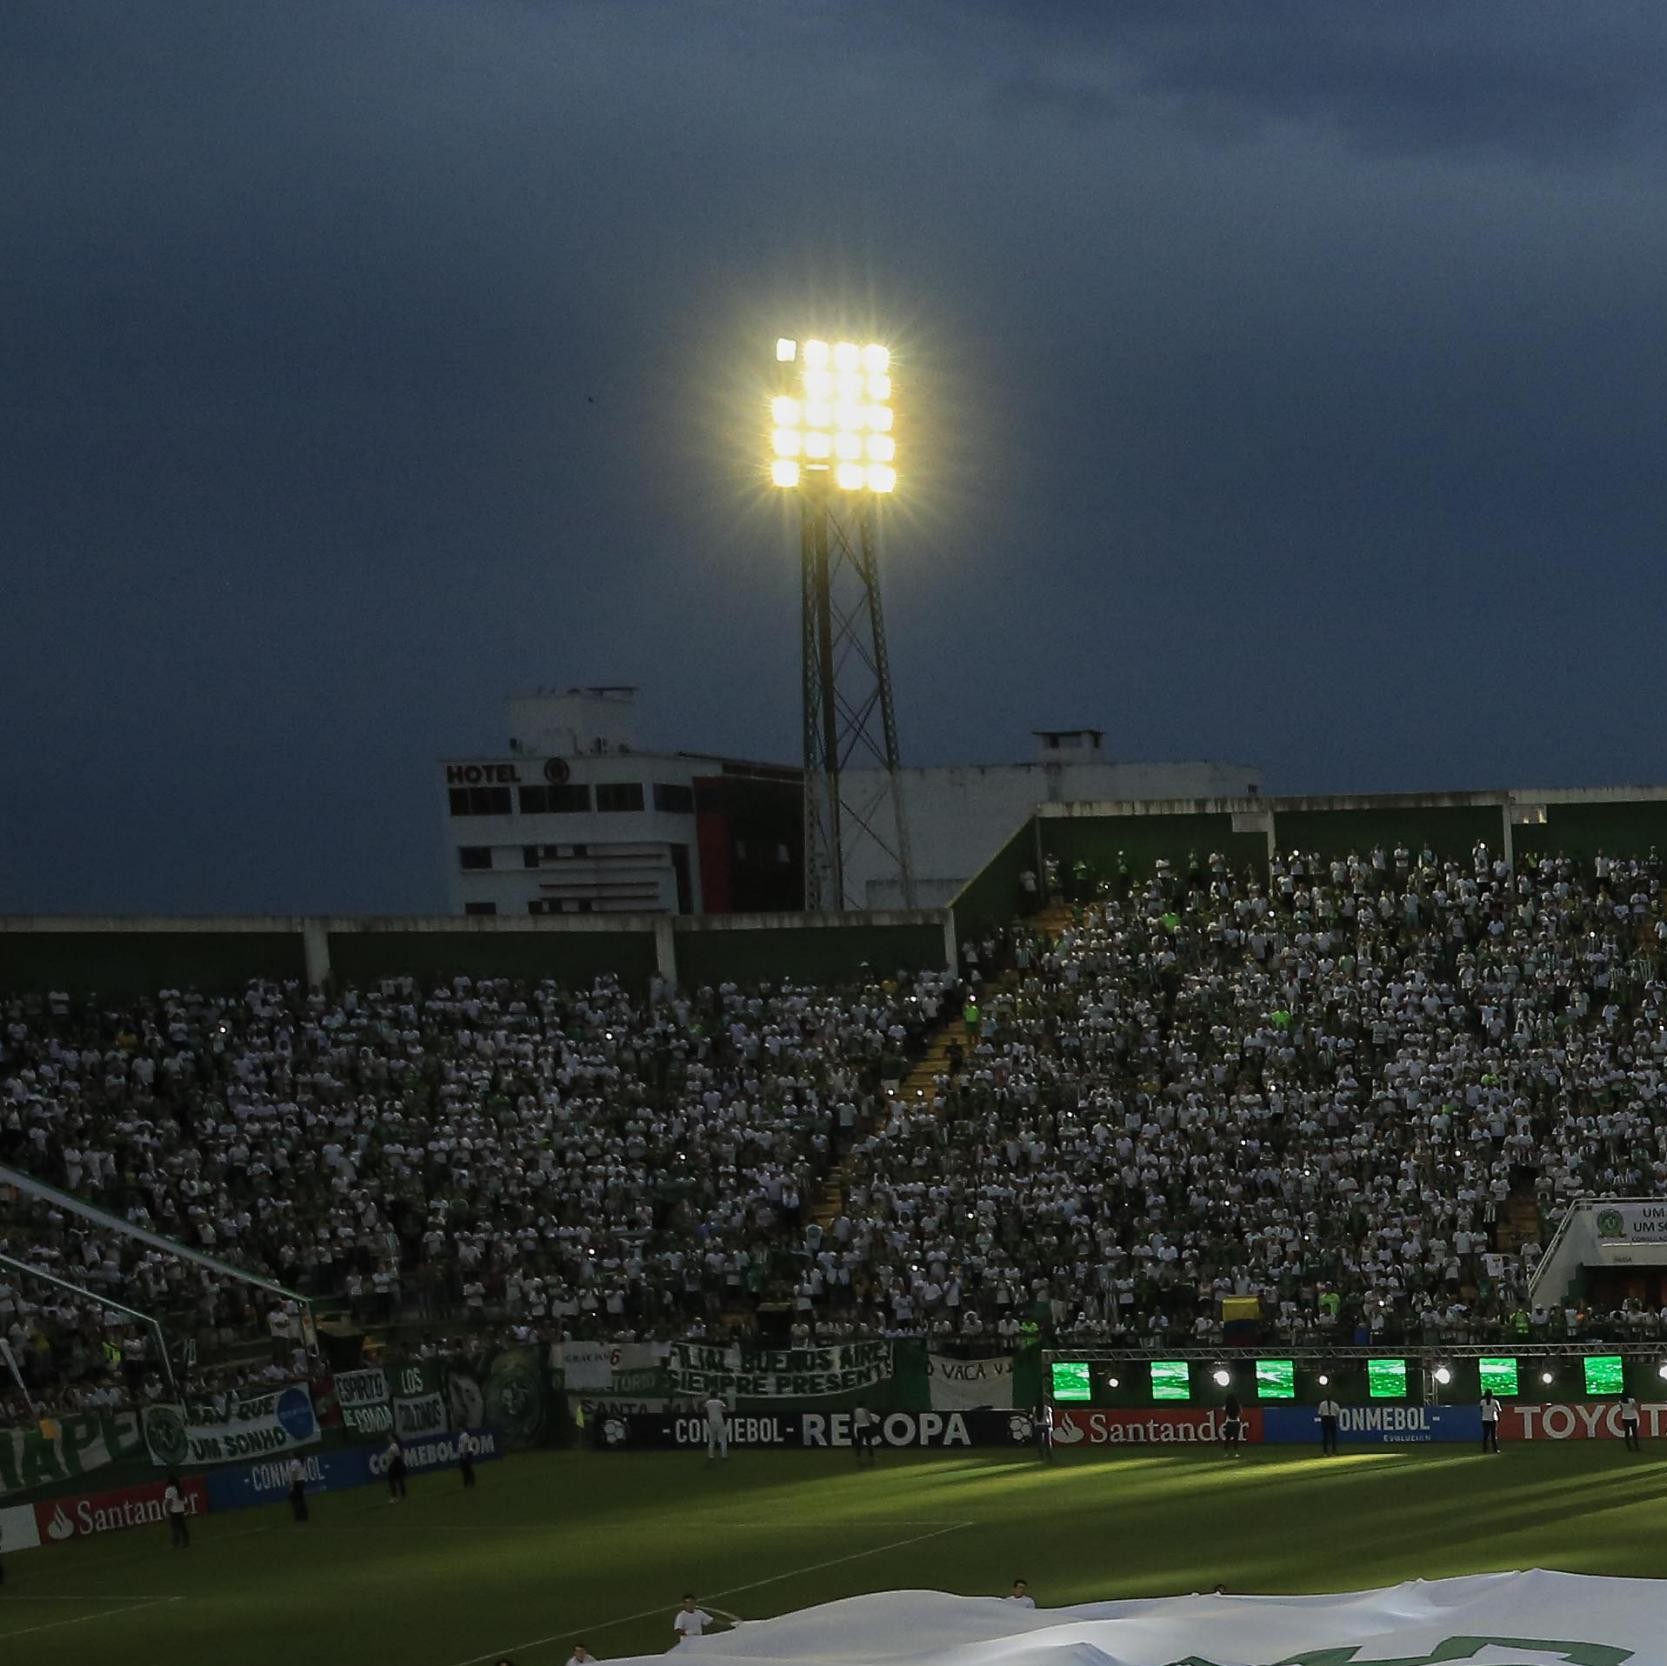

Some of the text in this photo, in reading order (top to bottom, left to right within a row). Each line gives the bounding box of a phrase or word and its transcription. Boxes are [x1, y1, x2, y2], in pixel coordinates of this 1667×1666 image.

[446, 764, 521, 783] HOTEL
[1643, 1208, 1664, 1218] UM
[1634, 1222, 1655, 1232] UM
[401, 1367, 424, 1394] LOS
[1320, 1407, 1431, 1433] ONMEBOL
